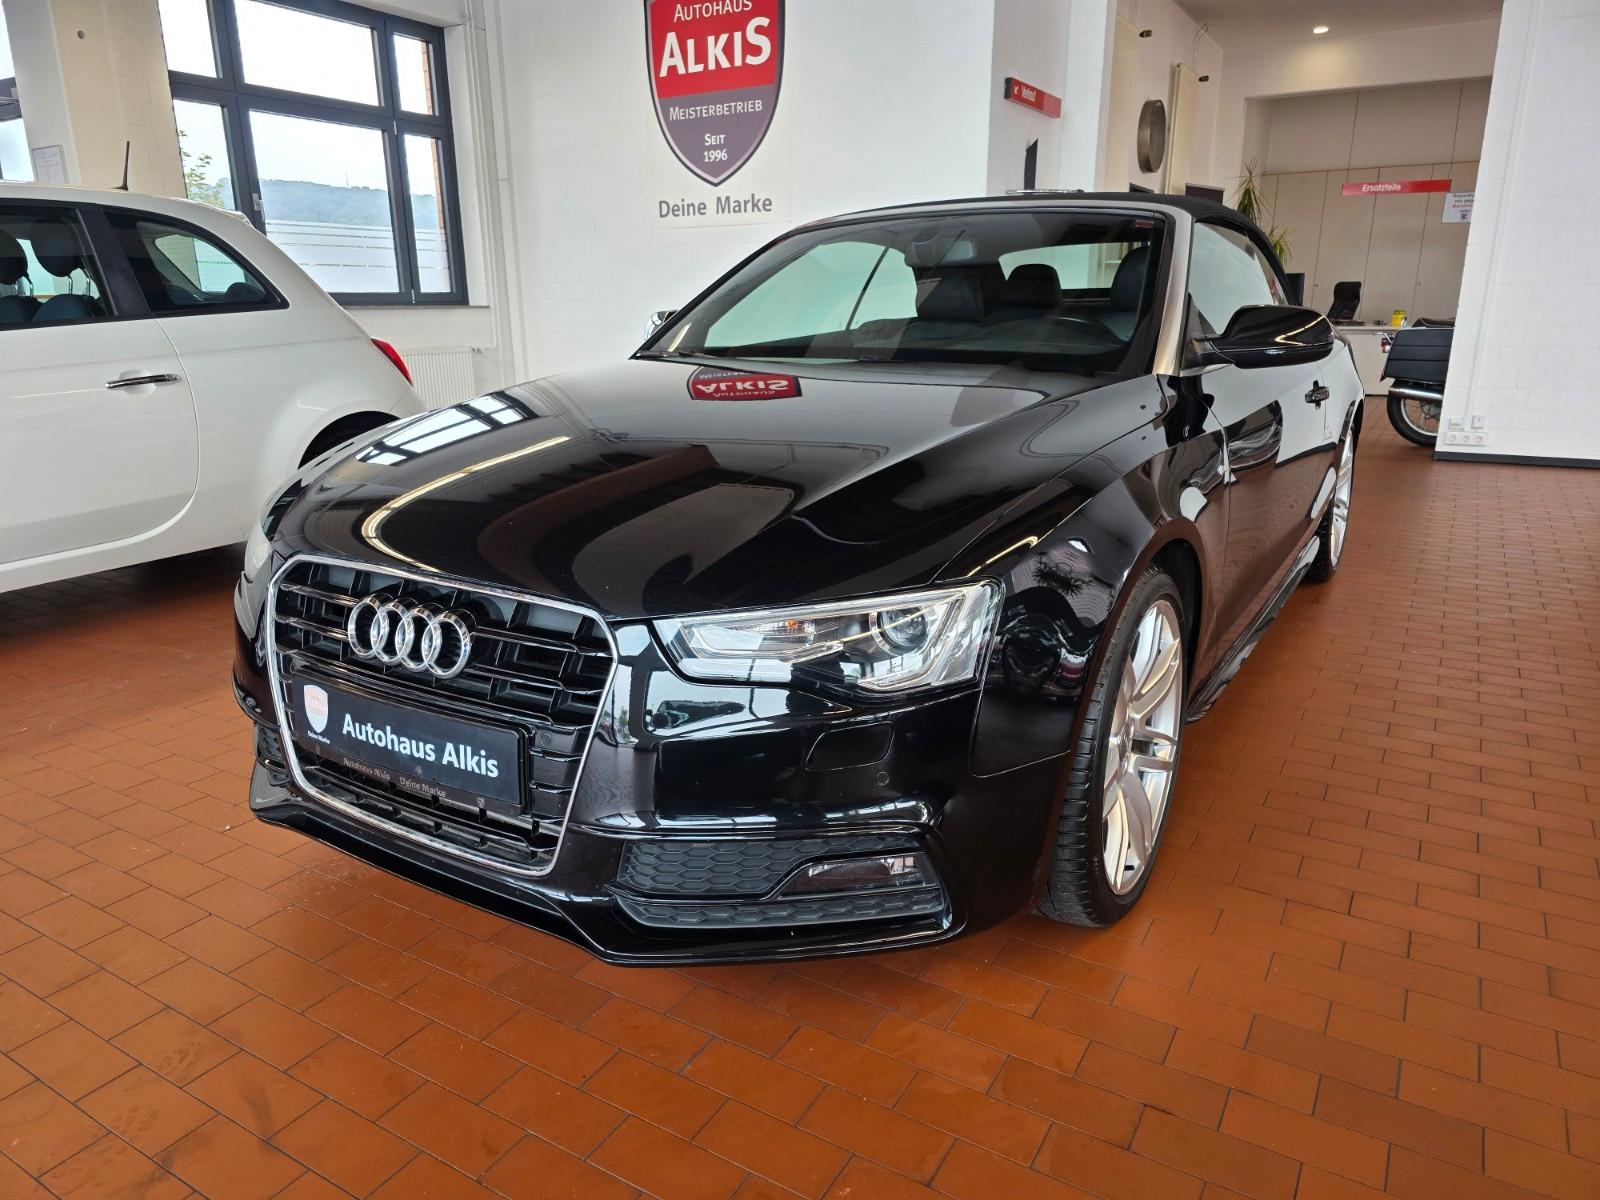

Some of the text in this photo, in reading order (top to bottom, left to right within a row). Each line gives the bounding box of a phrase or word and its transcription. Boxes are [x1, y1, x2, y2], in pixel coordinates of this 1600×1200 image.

[673, 0, 753, 22] AUTOHAUS
[659, 16, 772, 78] ALKIS
[669, 100, 763, 121] MEISTERBETRIEB
[704, 133, 725, 146] SEIT
[703, 149, 728, 162] 1996
[1361, 183, 1402, 192] Ersatzteile
[658, 193, 773, 218] Deine Marke
[342, 713, 499, 778] Autohaus Alkis
